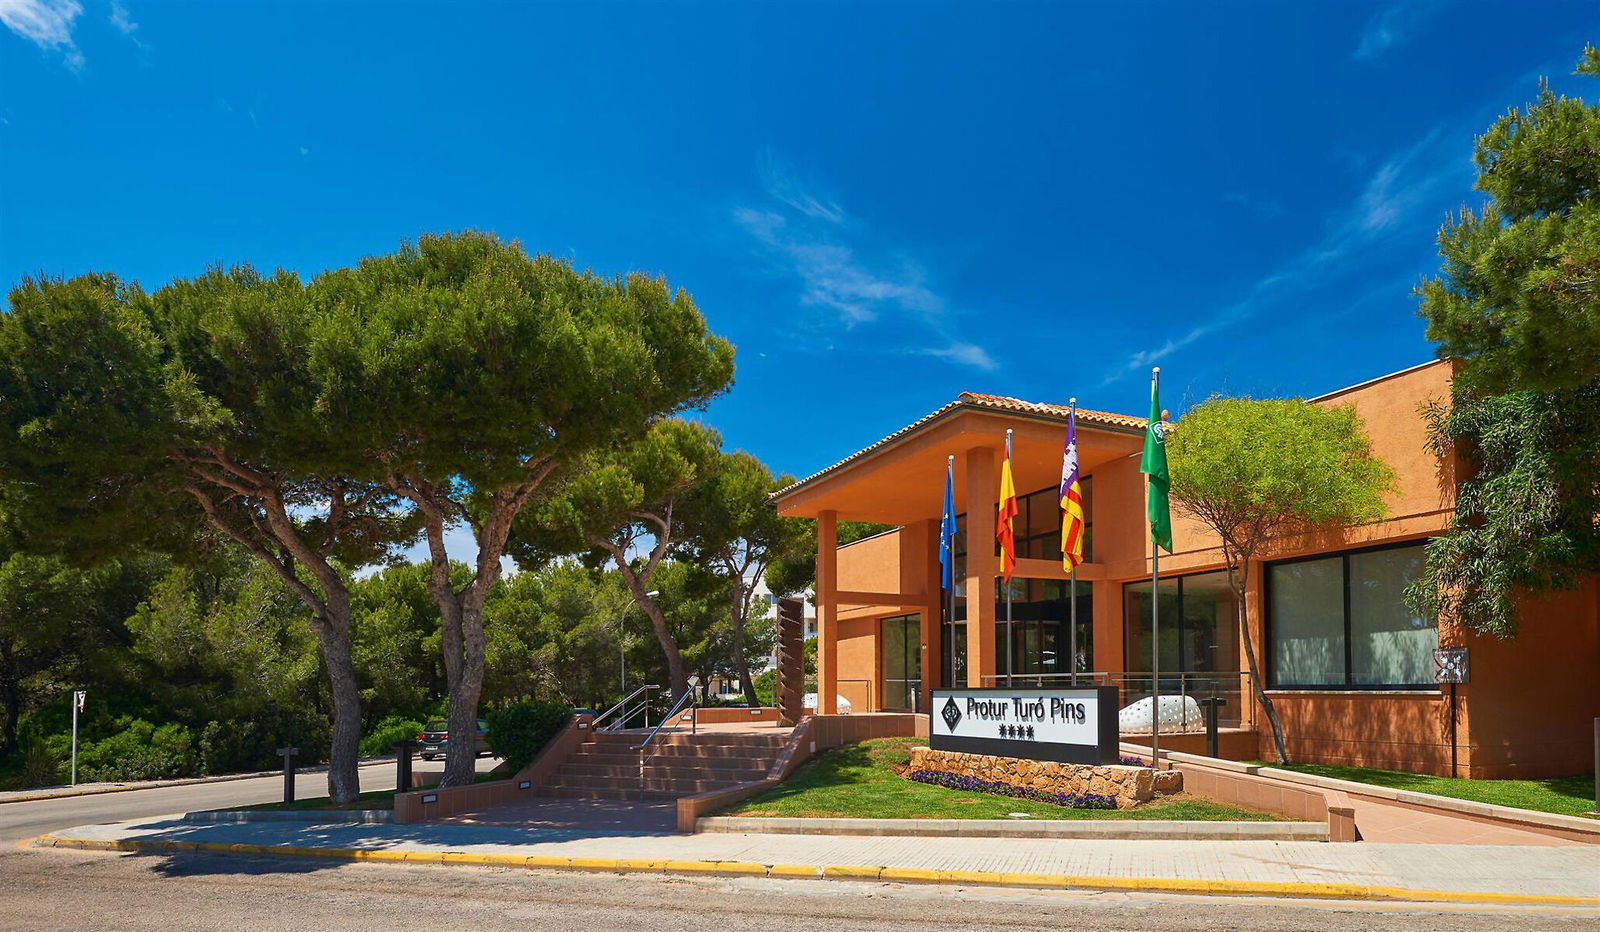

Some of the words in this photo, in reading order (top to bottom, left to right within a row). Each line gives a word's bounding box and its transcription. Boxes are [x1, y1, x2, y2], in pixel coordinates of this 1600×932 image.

[966, 697, 1009, 718] Protur
[1011, 696, 1045, 720] Turó
[1050, 697, 1086, 721] Pins
